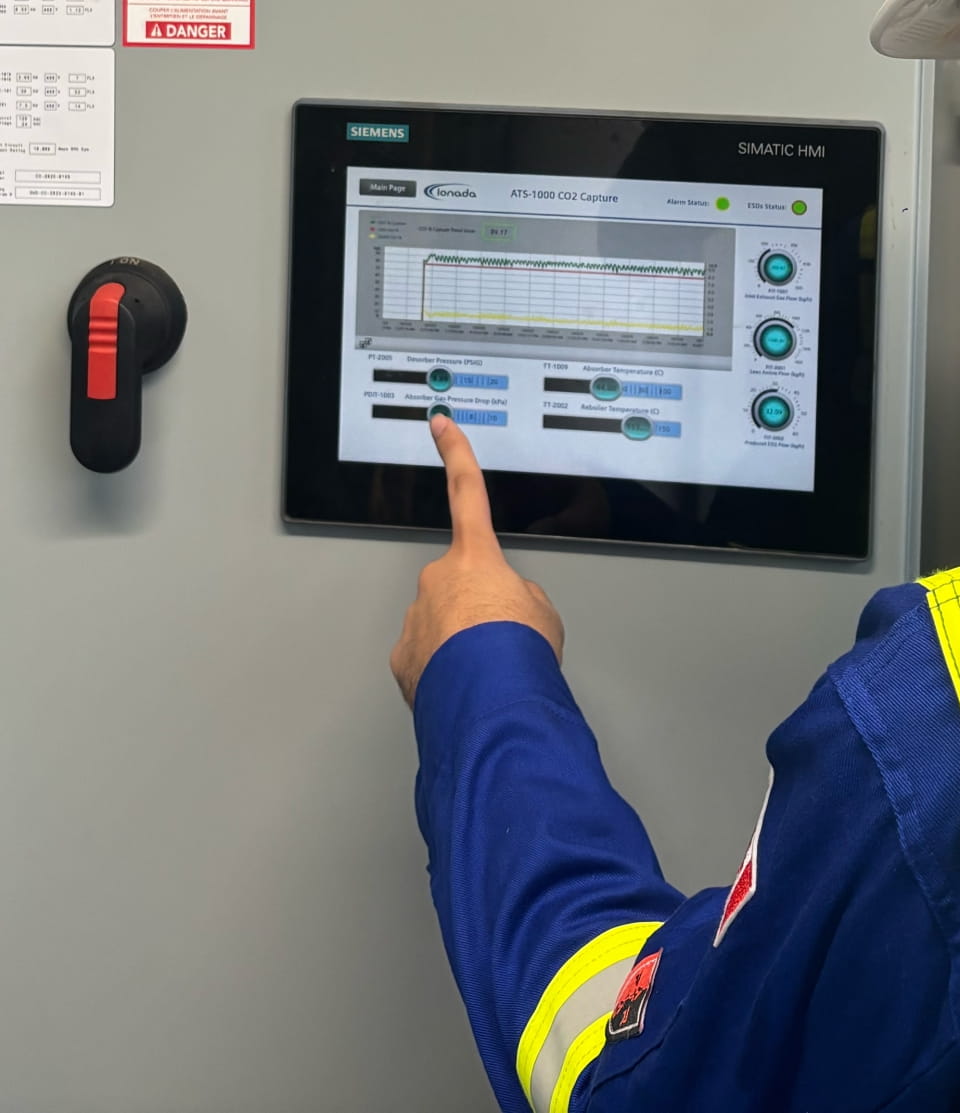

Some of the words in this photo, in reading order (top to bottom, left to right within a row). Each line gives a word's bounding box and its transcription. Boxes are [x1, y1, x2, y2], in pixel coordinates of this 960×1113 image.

[166, 24, 226, 38] DANGER
[351, 126, 405, 138] SIEMENS
[738, 142, 794, 156] SIMATIC
[798, 144, 825, 158] HMI
[389, 184, 406, 193] Page
[510, 189, 555, 200] ATS-1000
[558, 191, 577, 201] CO2
[580, 192, 619, 204] Capture
[667, 198, 686, 206] Alarm
[613, 367, 653, 376] Temperature
[608, 405, 649, 415] Temperature
